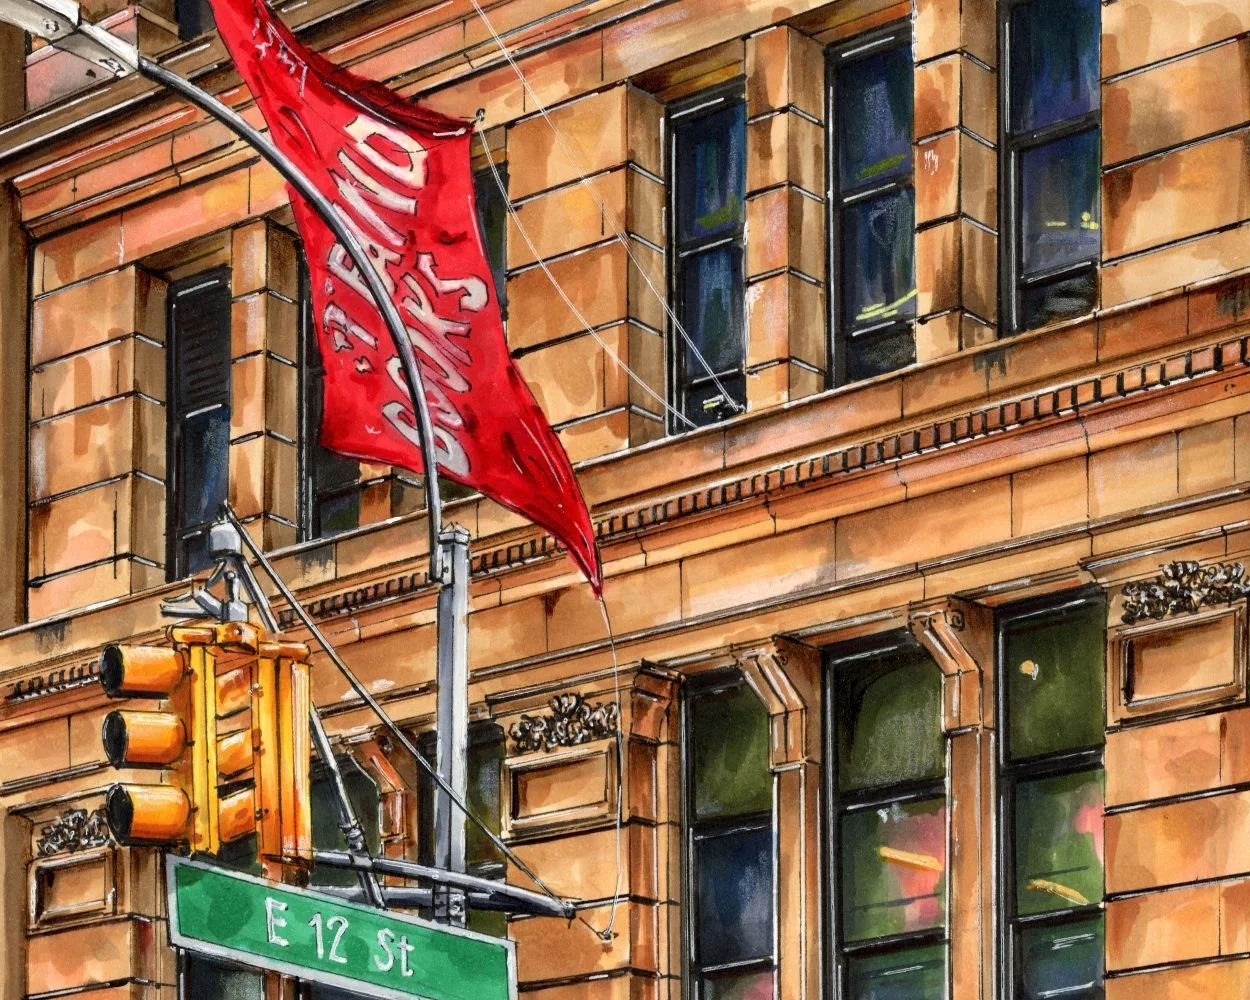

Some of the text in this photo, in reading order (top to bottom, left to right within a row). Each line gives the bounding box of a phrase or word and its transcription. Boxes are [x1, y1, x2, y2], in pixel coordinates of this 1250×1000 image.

[265, 898, 415, 976] E 12 St
